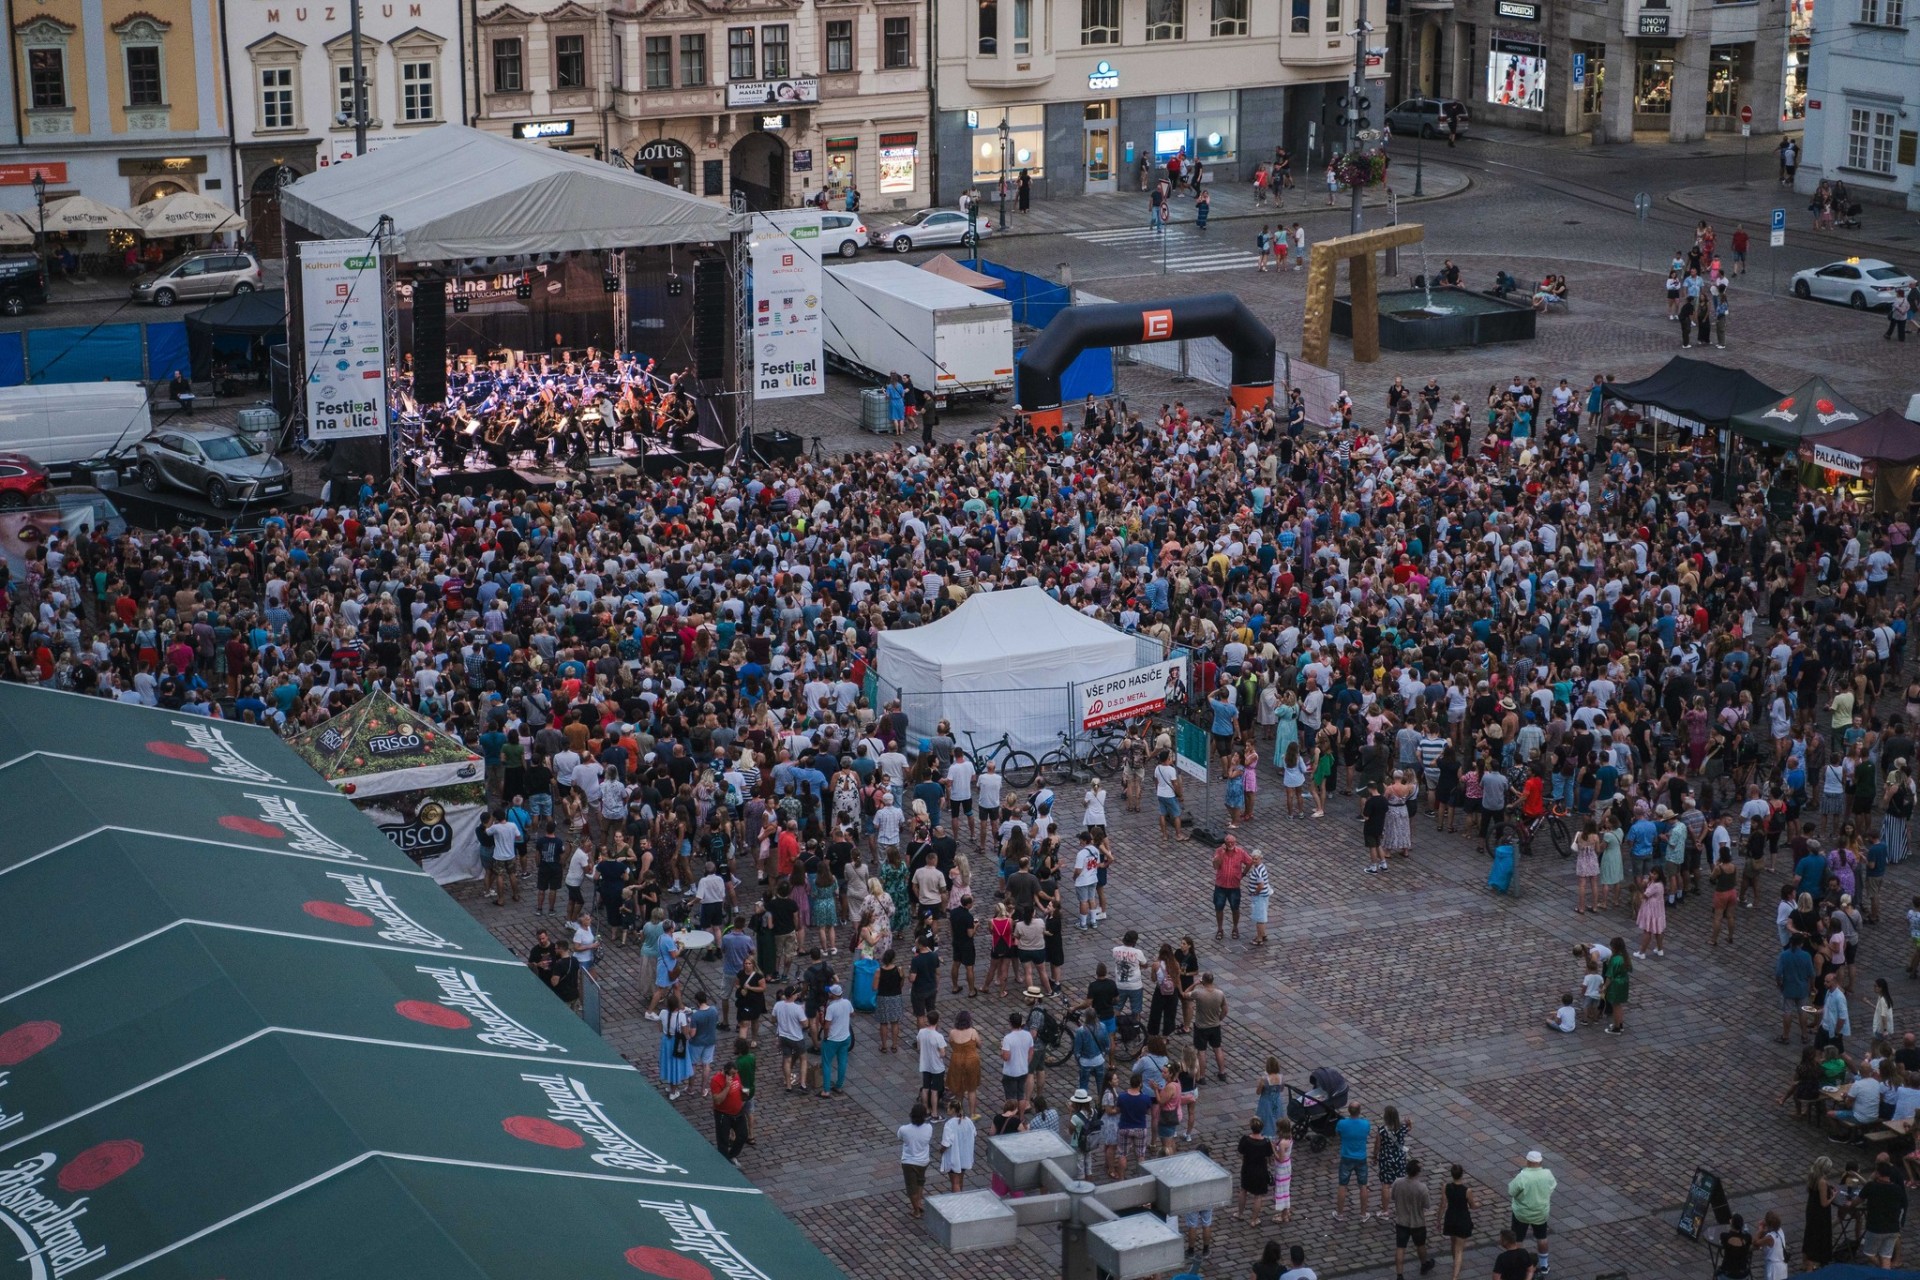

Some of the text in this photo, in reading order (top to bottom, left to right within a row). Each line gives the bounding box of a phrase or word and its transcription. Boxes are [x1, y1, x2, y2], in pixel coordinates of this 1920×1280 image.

[1641, 17, 1667, 25] SNOW
[1575, 68, 1583, 78] P
[1774, 211, 1783, 224] P
[761, 378, 779, 389] na
[316, 418, 337, 430] na
[1815, 450, 1860, 472] PALAČINKY
[1086, 668, 1162, 698] VŠE PRO HASIČE
[1127, 691, 1148, 702] METAL
[319, 728, 344, 749] FRISCO
[369, 734, 420, 752] FRISCO
[386, 823, 447, 848] RISCO
